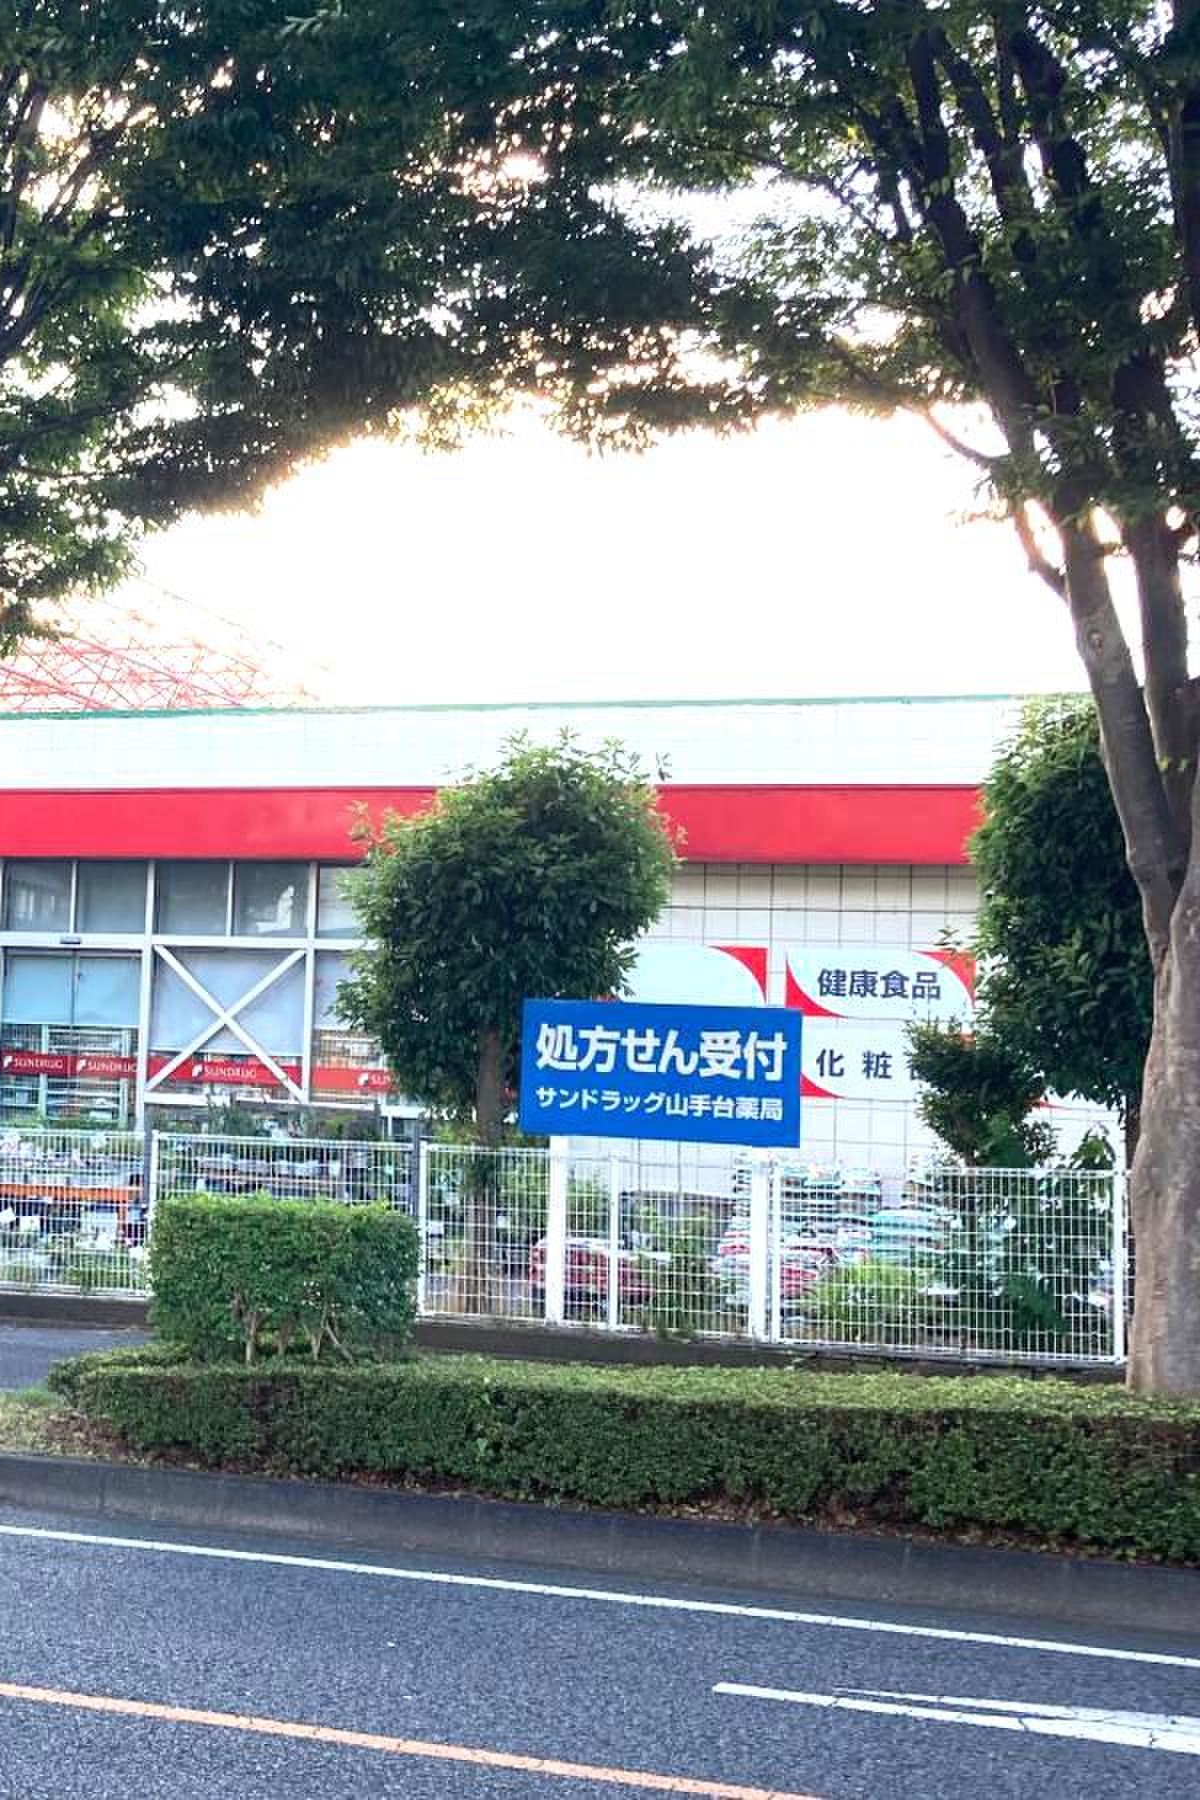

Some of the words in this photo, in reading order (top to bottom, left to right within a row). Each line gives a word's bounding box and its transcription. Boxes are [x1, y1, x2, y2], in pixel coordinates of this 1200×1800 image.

[817, 967, 942, 1001] 健康食品
[13, 1055, 64, 1069] SUNDRUG
[536, 1023, 788, 1082] 処方せん受付
[815, 1048, 930, 1081] 化粧
[204, 1065, 257, 1079] SUNDRUG
[535, 1086, 784, 1121] サンドラッグ山手台薬局
